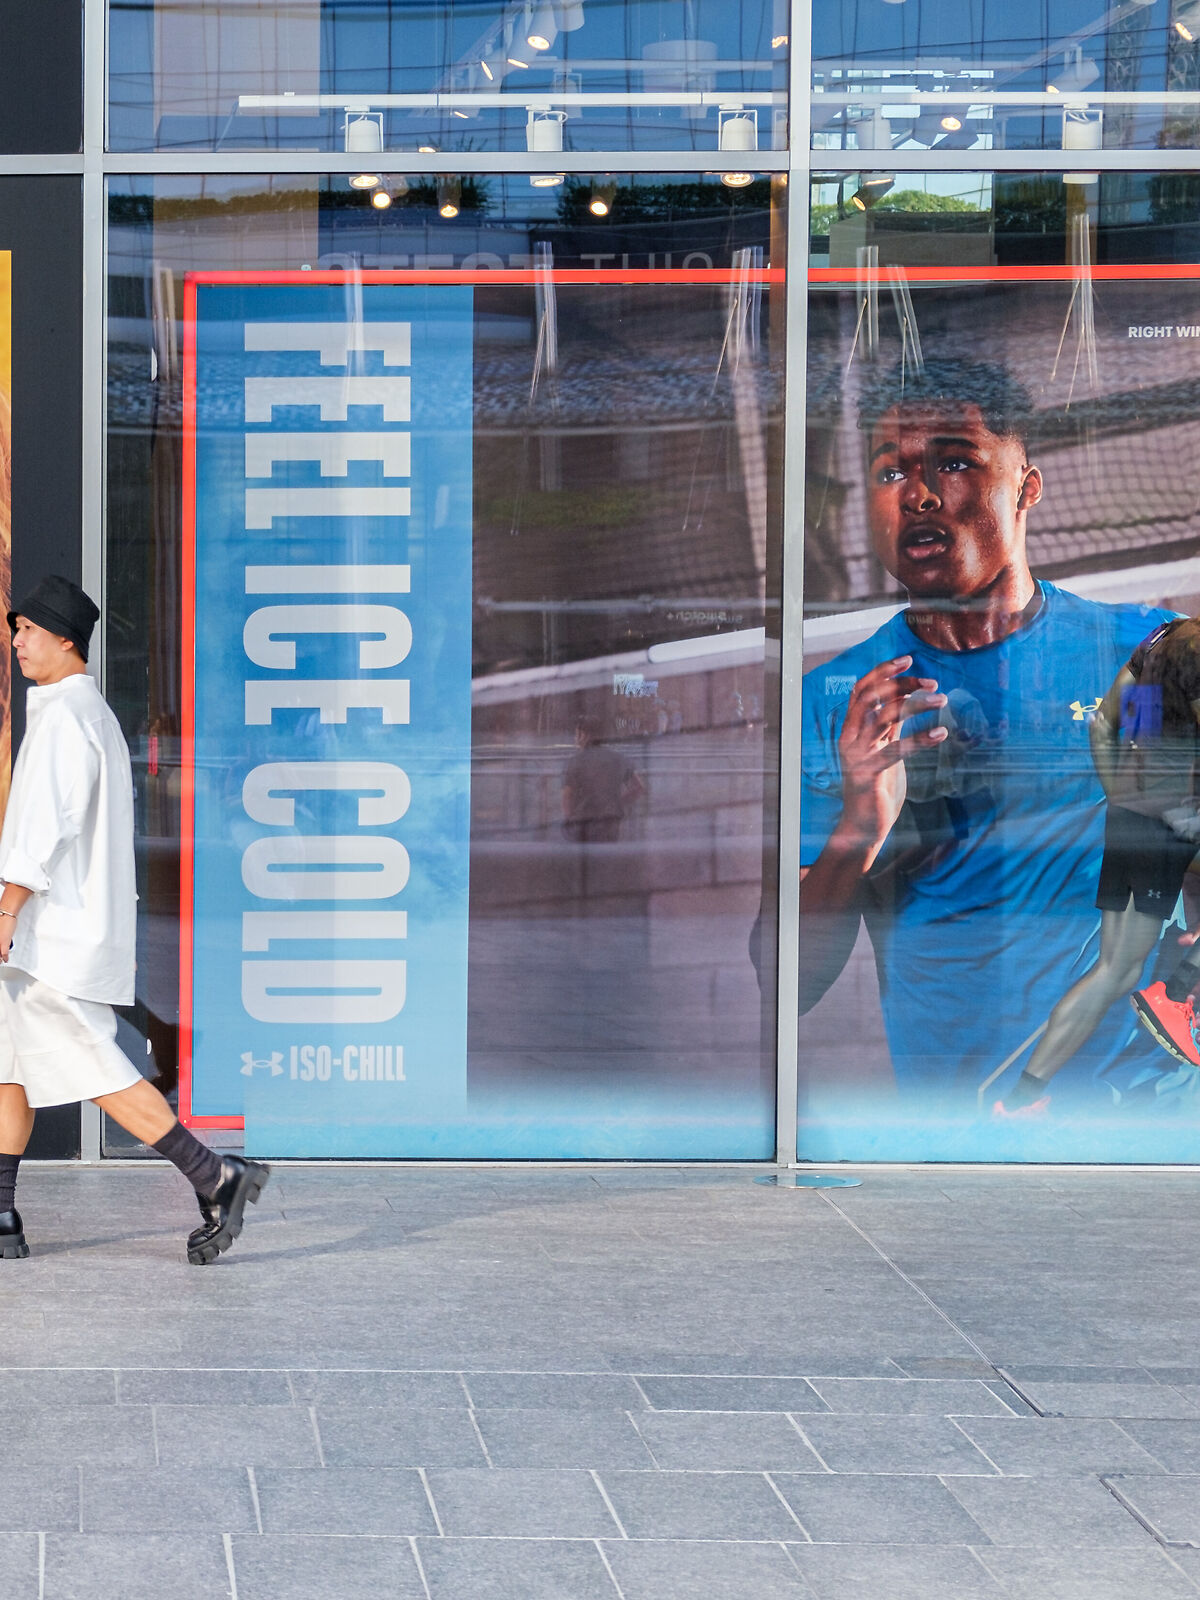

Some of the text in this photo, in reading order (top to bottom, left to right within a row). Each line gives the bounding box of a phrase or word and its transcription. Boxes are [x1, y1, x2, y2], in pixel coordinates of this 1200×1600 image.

[1128, 326, 1173, 338] RIGHT
[240, 321, 413, 1024] FEEL ICE COLD
[289, 1045, 407, 1082] ISO-CHILL
